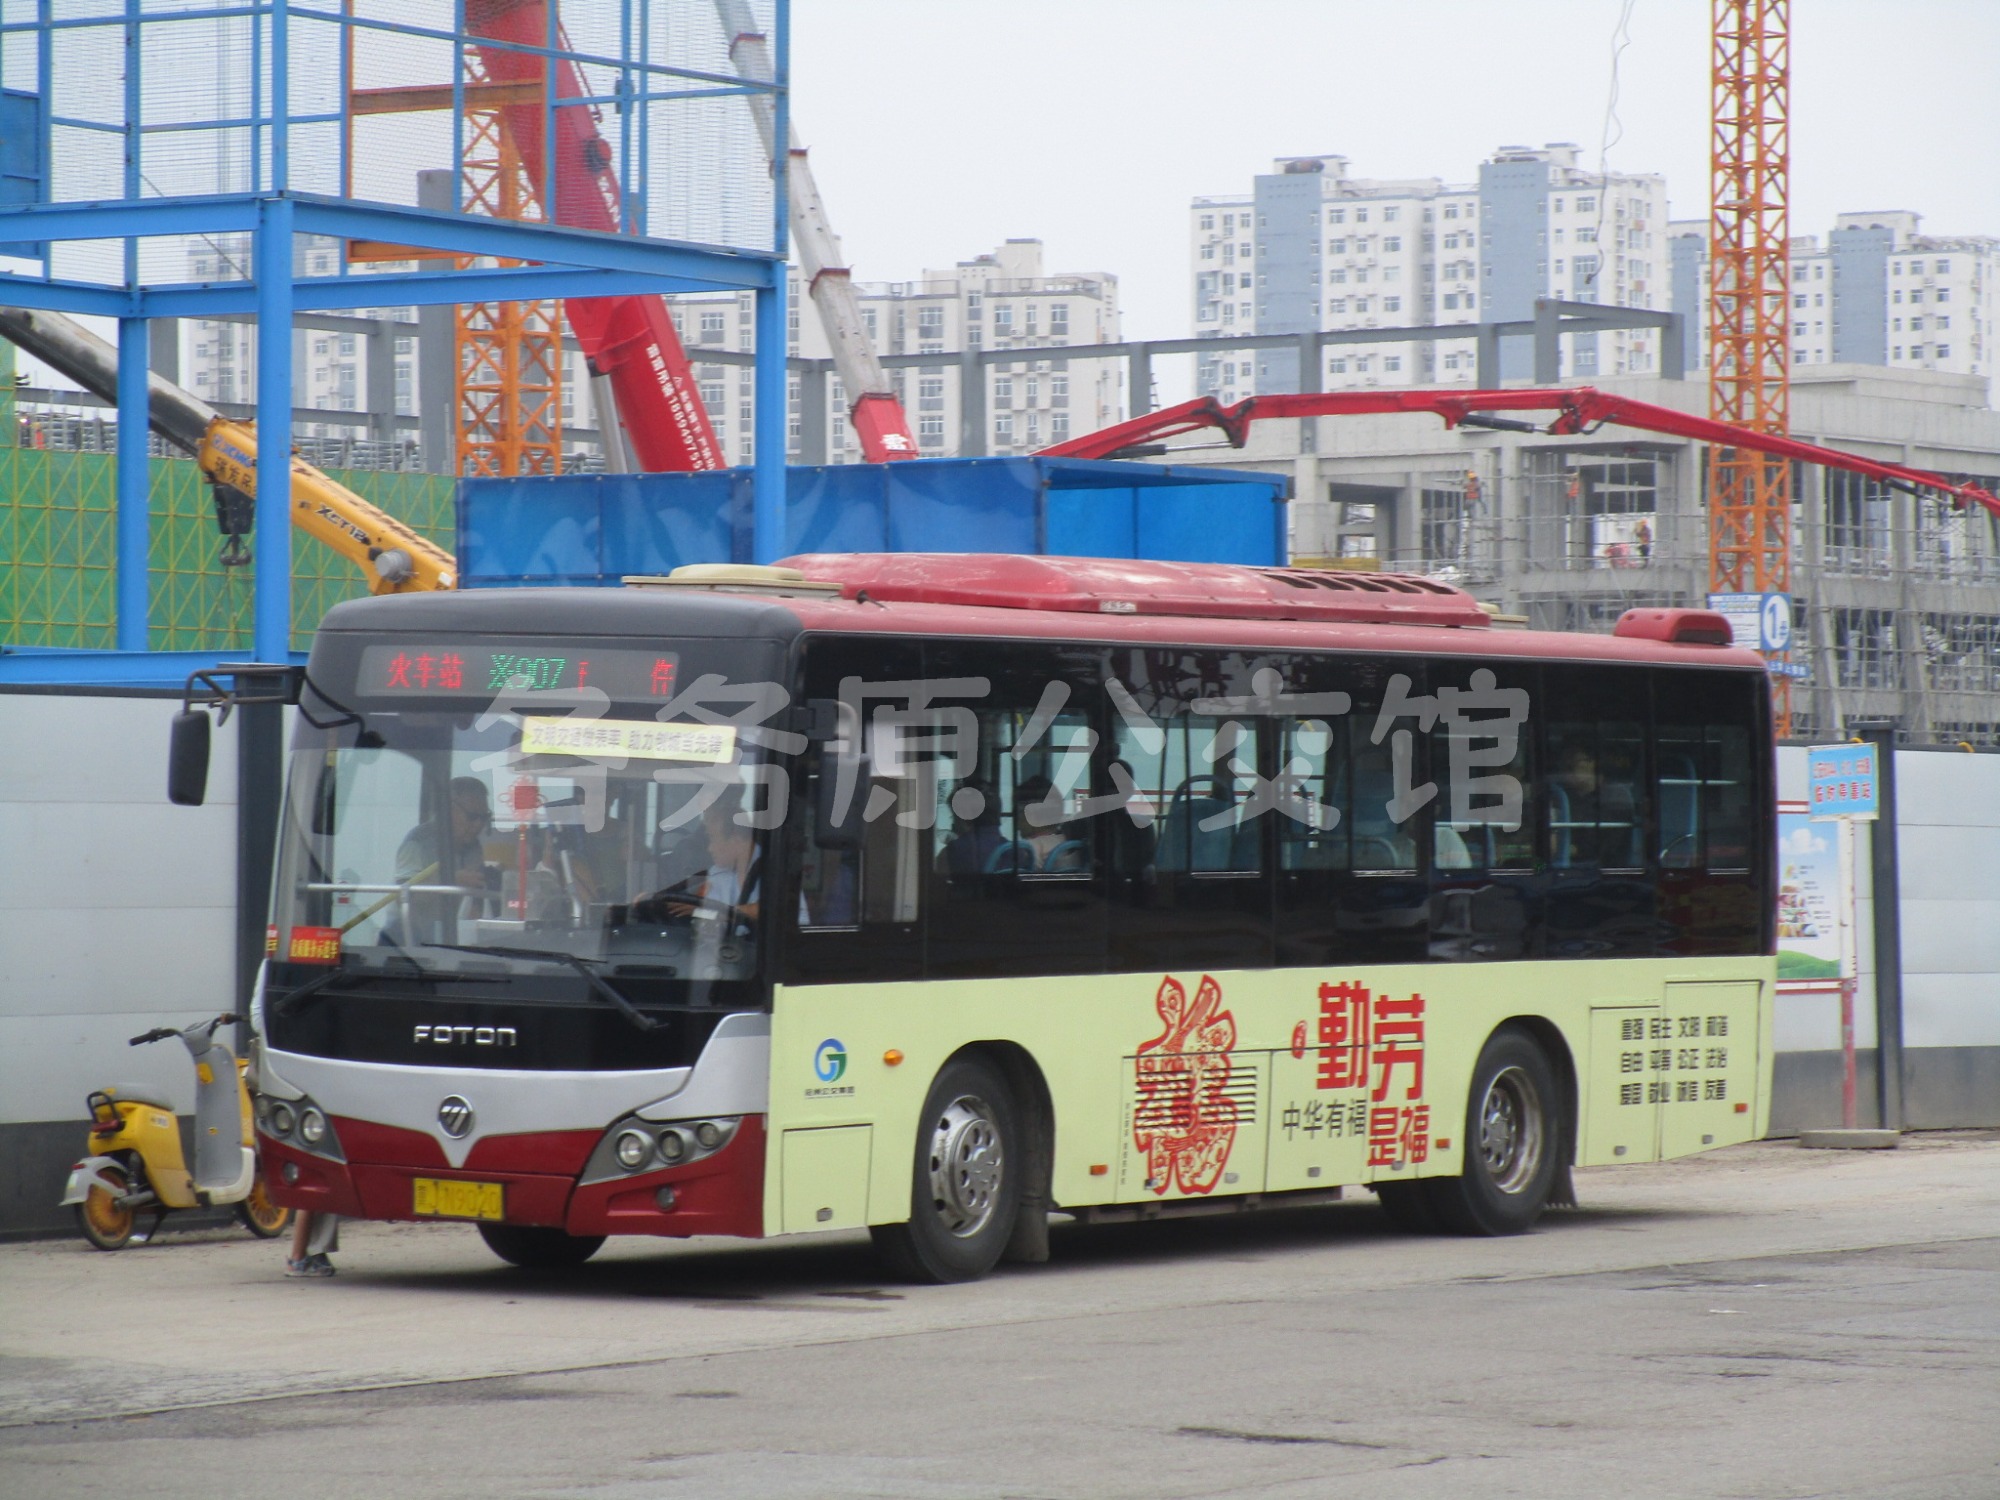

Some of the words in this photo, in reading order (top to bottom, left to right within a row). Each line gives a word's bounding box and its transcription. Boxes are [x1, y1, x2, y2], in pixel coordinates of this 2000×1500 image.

[597, 176, 621, 233] SAN
[387, 652, 465, 690] 火车站
[414, 1025, 517, 1047] FOTON
[1316, 980, 1425, 1102] 勤劳
[1282, 1099, 1367, 1141] 中华有福
[1367, 1105, 1430, 1167] 是福
